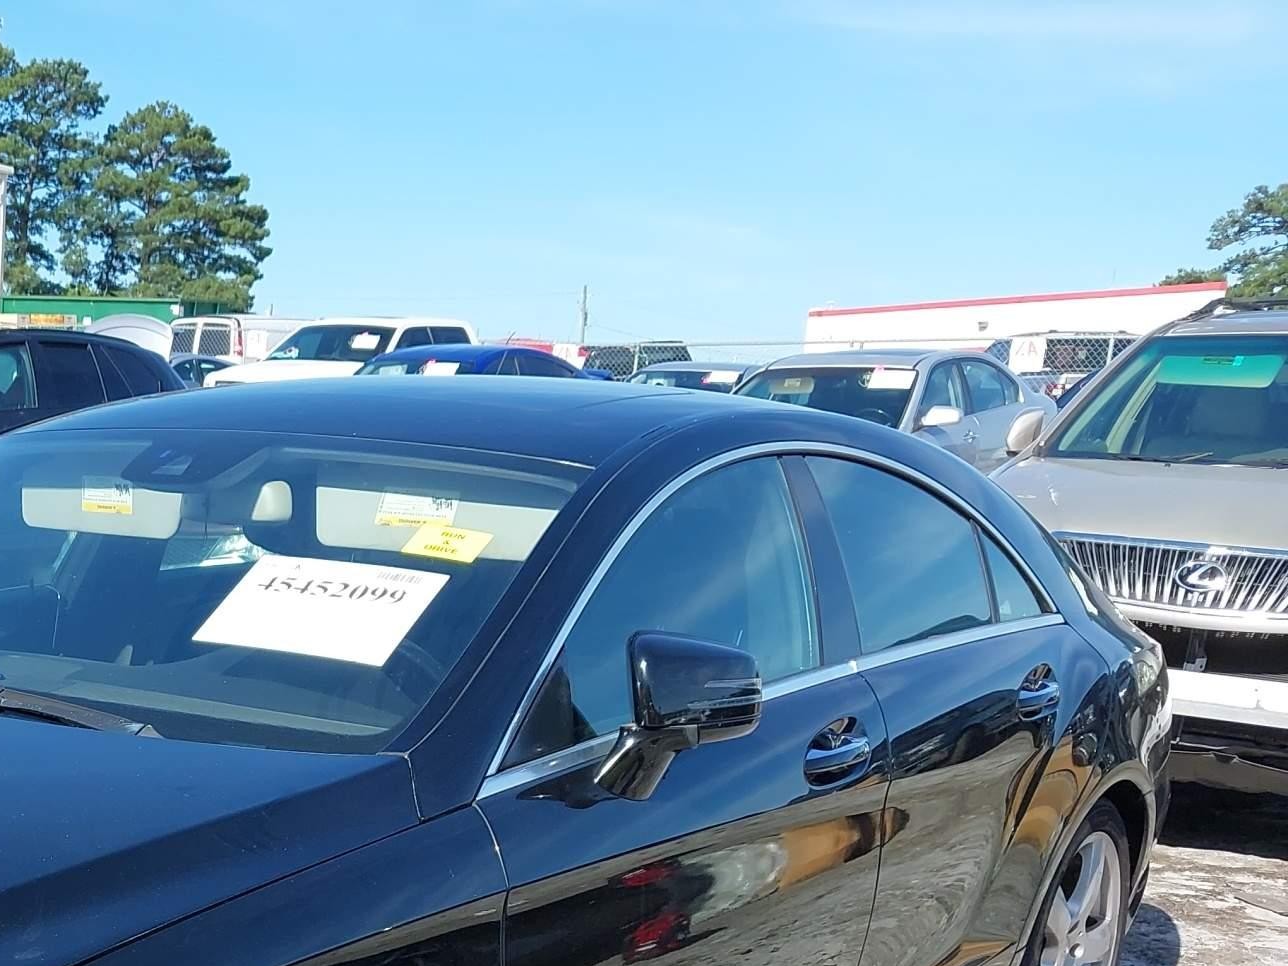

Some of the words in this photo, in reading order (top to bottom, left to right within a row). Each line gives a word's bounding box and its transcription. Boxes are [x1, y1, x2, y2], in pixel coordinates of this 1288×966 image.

[441, 531, 466, 540] RUN
[423, 544, 458, 554] DRIVE
[258, 576, 407, 604] 45452099
